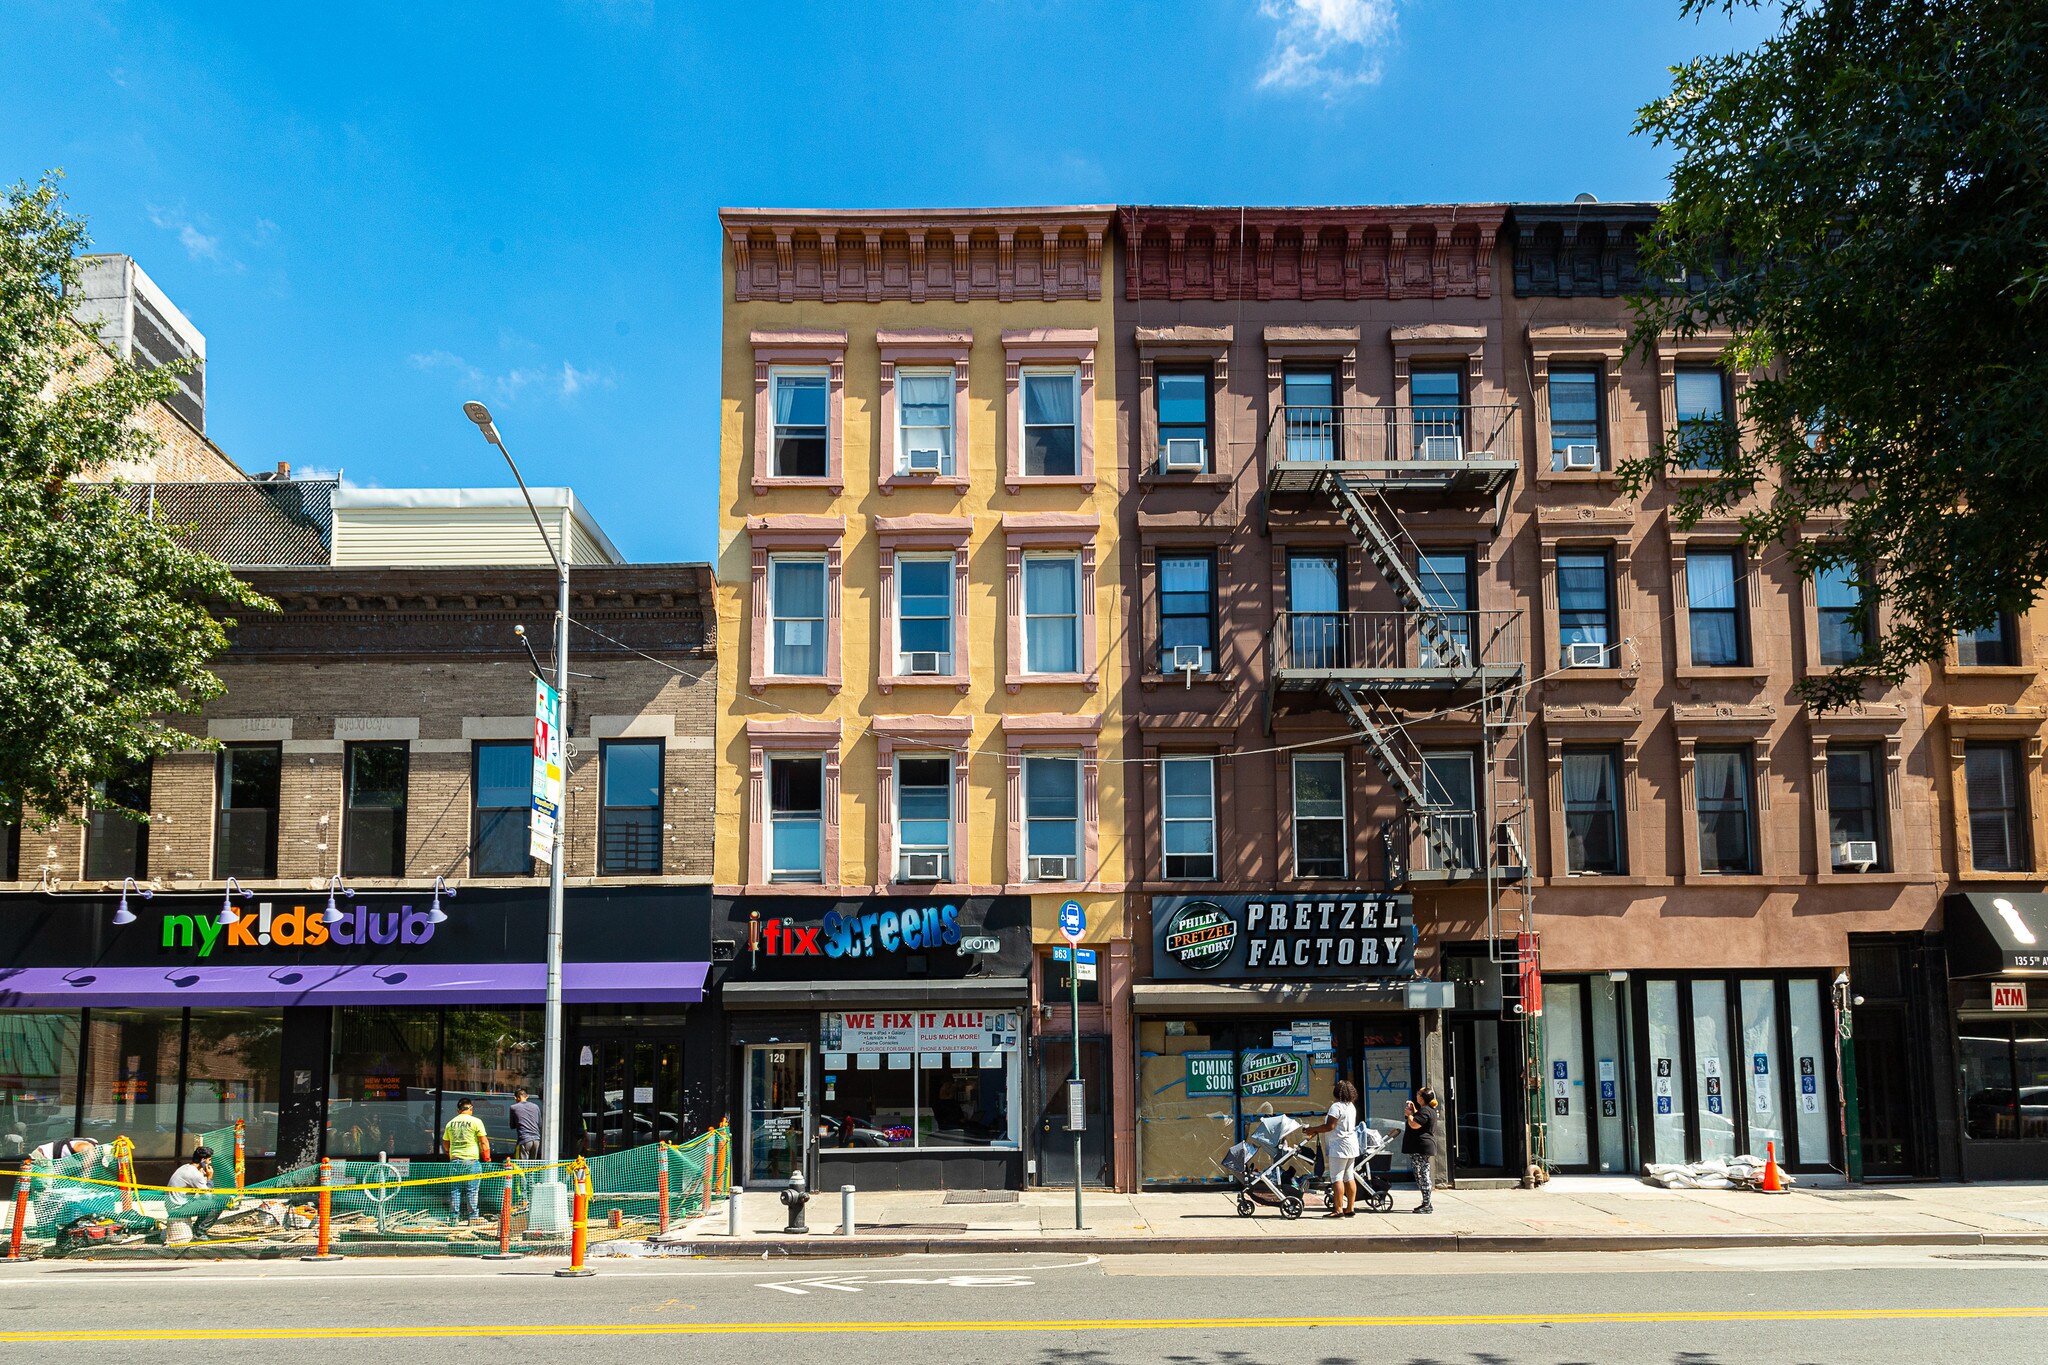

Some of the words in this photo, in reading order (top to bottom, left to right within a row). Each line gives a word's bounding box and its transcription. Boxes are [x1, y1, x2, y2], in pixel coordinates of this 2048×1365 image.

[1179, 912, 1218, 931] PHILLY
[1248, 902, 1399, 931] PRETZEL
[1174, 925, 1231, 948] PRETZEL
[1055, 949, 1067, 959] B63
[1181, 940, 1230, 960] FACTORY
[1248, 937, 1403, 966] FACTORY
[2014, 956, 2028, 966] 135
[2029, 956, 2040, 966] 5TH
[1995, 989, 2023, 1005] ATM
[845, 1014, 875, 1029] WE
[883, 1014, 913, 1029] FIX
[920, 1014, 937, 1028] IT
[943, 1012, 983, 1028] ALL!
[769, 1053, 785, 1063] 129
[1250, 1054, 1283, 1069] PHILLY
[1192, 1060, 1234, 1075] COMING
[1246, 1064, 1294, 1083] PRETZEL
[1206, 1075, 1234, 1090] SOON
[1252, 1076, 1293, 1094] FACTORY
[884, 1128, 912, 1138] OPEN
